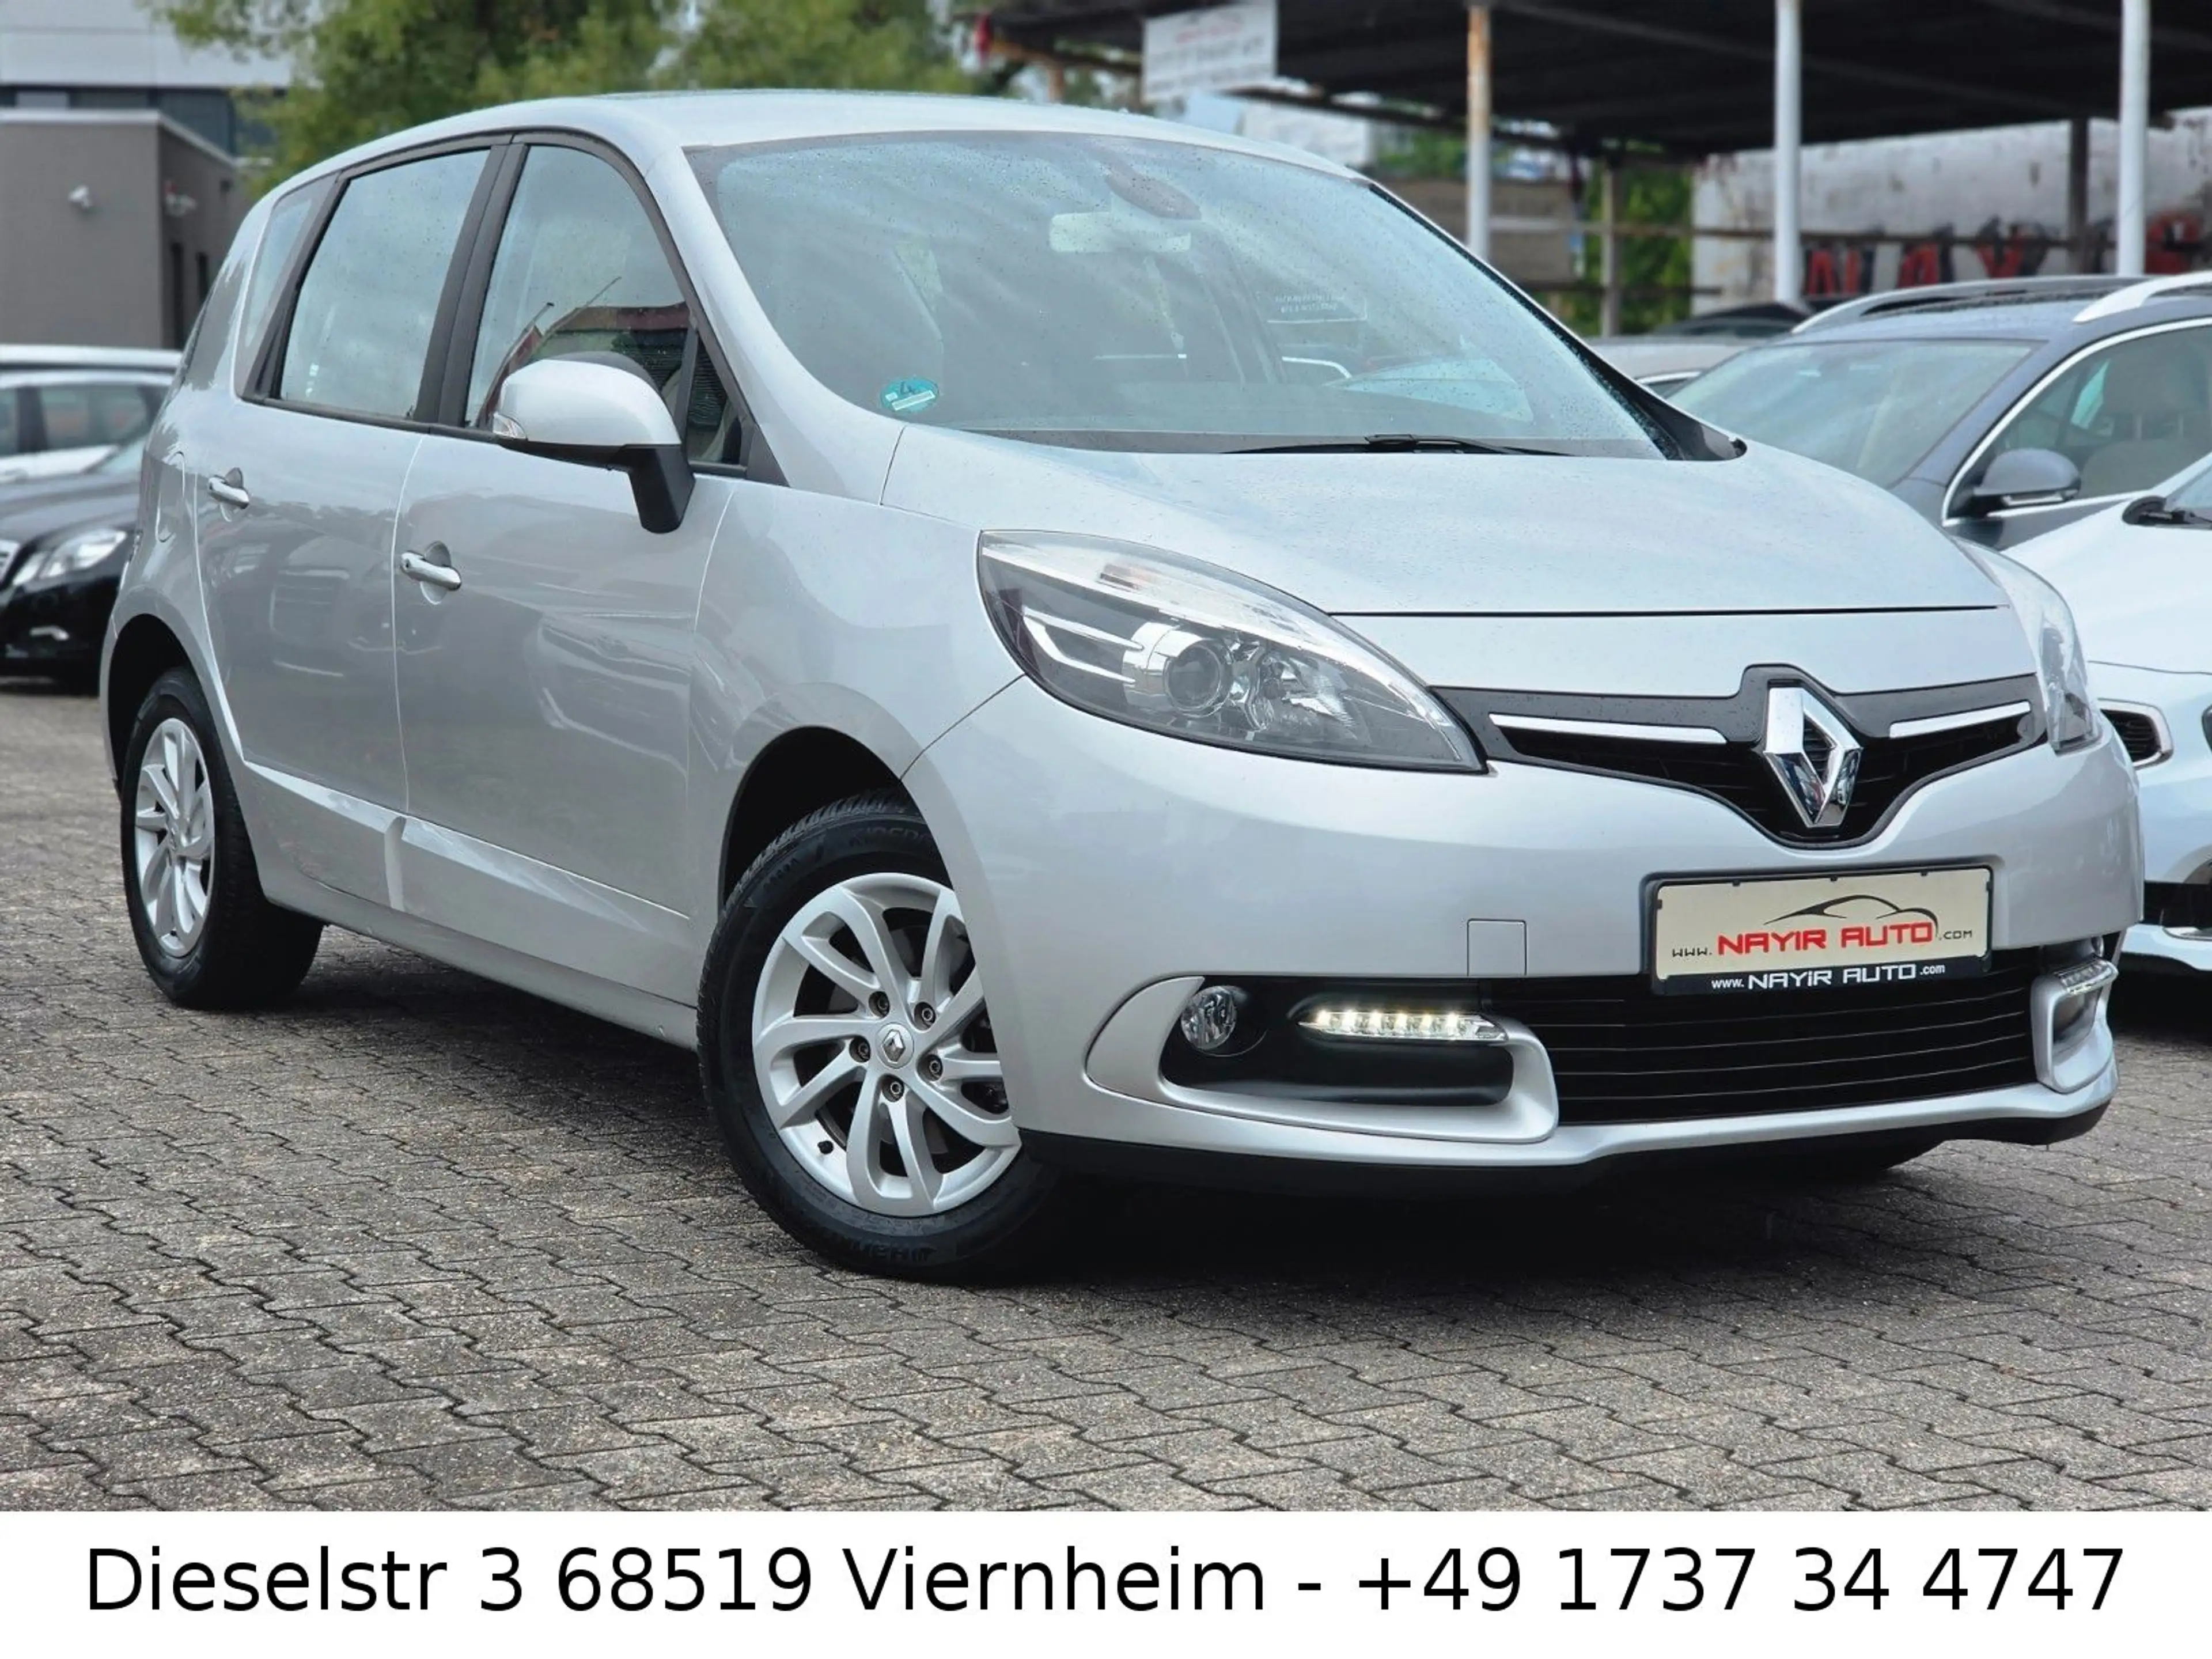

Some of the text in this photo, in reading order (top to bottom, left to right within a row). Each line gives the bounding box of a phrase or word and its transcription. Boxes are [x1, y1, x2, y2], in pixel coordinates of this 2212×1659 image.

[1718, 929, 1827, 956] NAYIR
[1840, 922, 1933, 948] AUTO
[1711, 978, 1744, 989] www.
[1843, 964, 1916, 984] AUTO
[1919, 964, 1945, 975] .com
